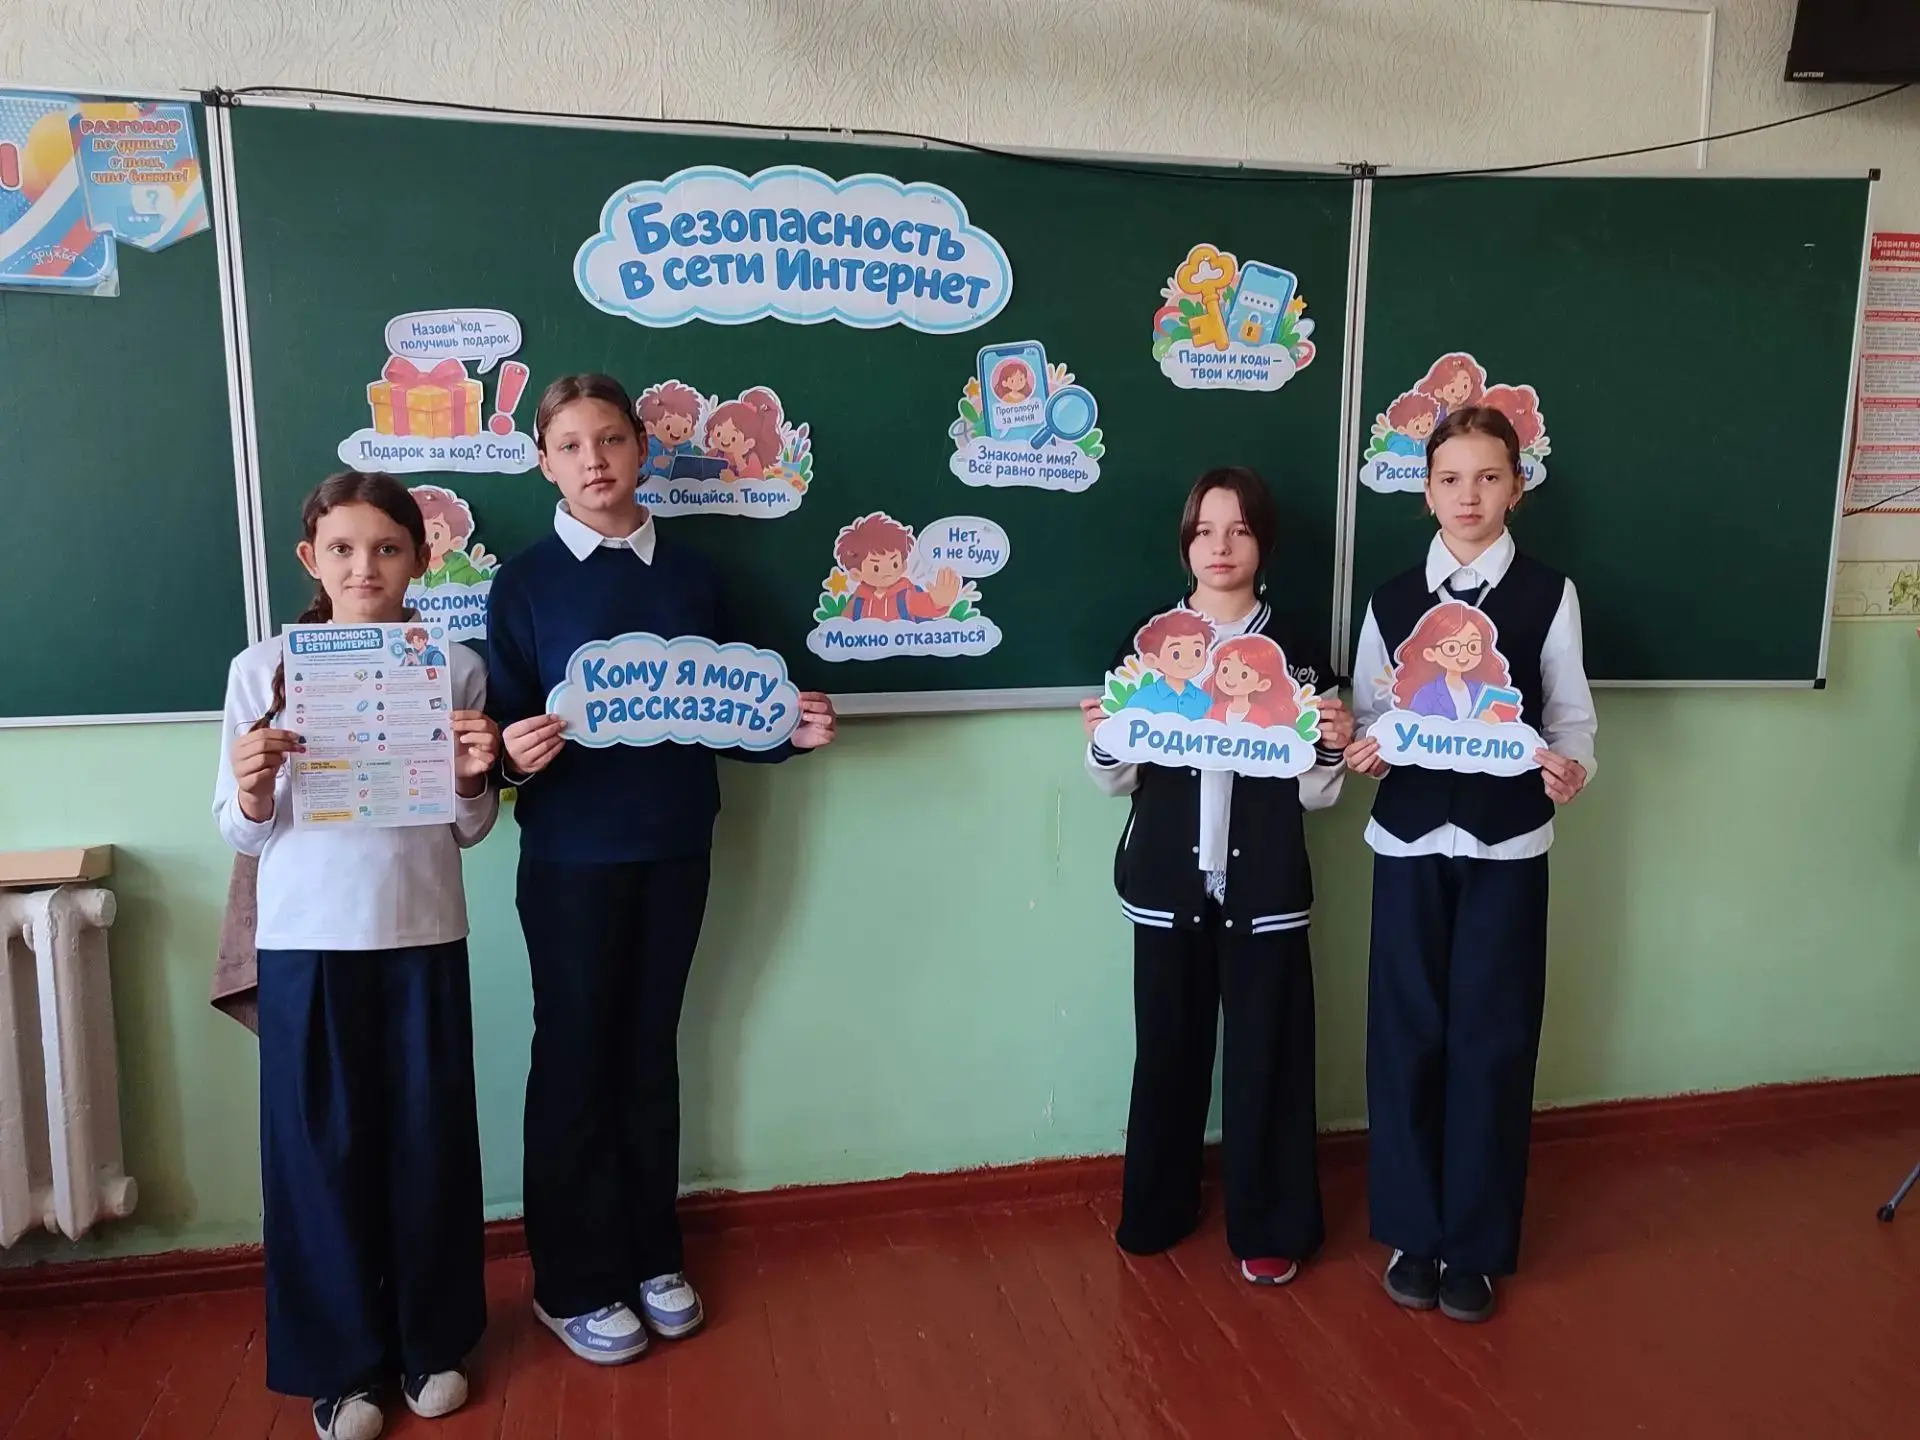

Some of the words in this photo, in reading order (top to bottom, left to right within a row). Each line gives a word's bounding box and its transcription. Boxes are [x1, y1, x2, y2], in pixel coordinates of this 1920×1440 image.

[81, 120, 181, 133] РАЗГОВОР
[628, 202, 965, 262] Безопасность
[619, 261, 655, 300] в
[662, 253, 765, 291] сети
[776, 248, 991, 309] Интернет
[411, 322, 455, 336] Назови
[461, 322, 482, 333] код
[401, 337, 459, 351] получишь
[463, 333, 510, 348] подарок
[1179, 350, 1227, 365] Пароли
[1229, 354, 1237, 364] и
[1240, 354, 1271, 366] коды
[1190, 368, 1222, 380] твои
[1226, 368, 1269, 380] ключи
[996, 402, 1040, 416] Проголосуй
[1002, 417, 1012, 425] за
[1014, 413, 1035, 423] меня
[360, 441, 424, 460] Подарок
[429, 447, 445, 458] за
[450, 444, 482, 460] код?
[486, 443, 525, 460] Стоп!
[978, 445, 1043, 464] Знакомое
[1046, 451, 1077, 466] имя?
[968, 459, 992, 474] Всё
[996, 463, 1036, 479] равно
[1039, 466, 1089, 483] проверь
[669, 488, 739, 506] Общайся.
[740, 488, 790, 507] Твори.
[949, 527, 980, 544] Нет,
[932, 547, 941, 559] я
[947, 547, 963, 558] не
[967, 545, 1000, 565] буду
[295, 629, 379, 643] БЕЗОПАСНОСТЬ
[296, 643, 304, 653] В
[305, 641, 331, 652] СЕТИ
[333, 638, 380, 650] ИНТЕРНЕТ
[825, 630, 888, 648] Можно
[894, 628, 986, 646] отказаться
[582, 658, 669, 692] Кому
[702, 663, 779, 704] могу
[585, 696, 786, 733] рассказать?
[1128, 719, 1290, 764] Родителям
[1394, 722, 1525, 760] Учителю
